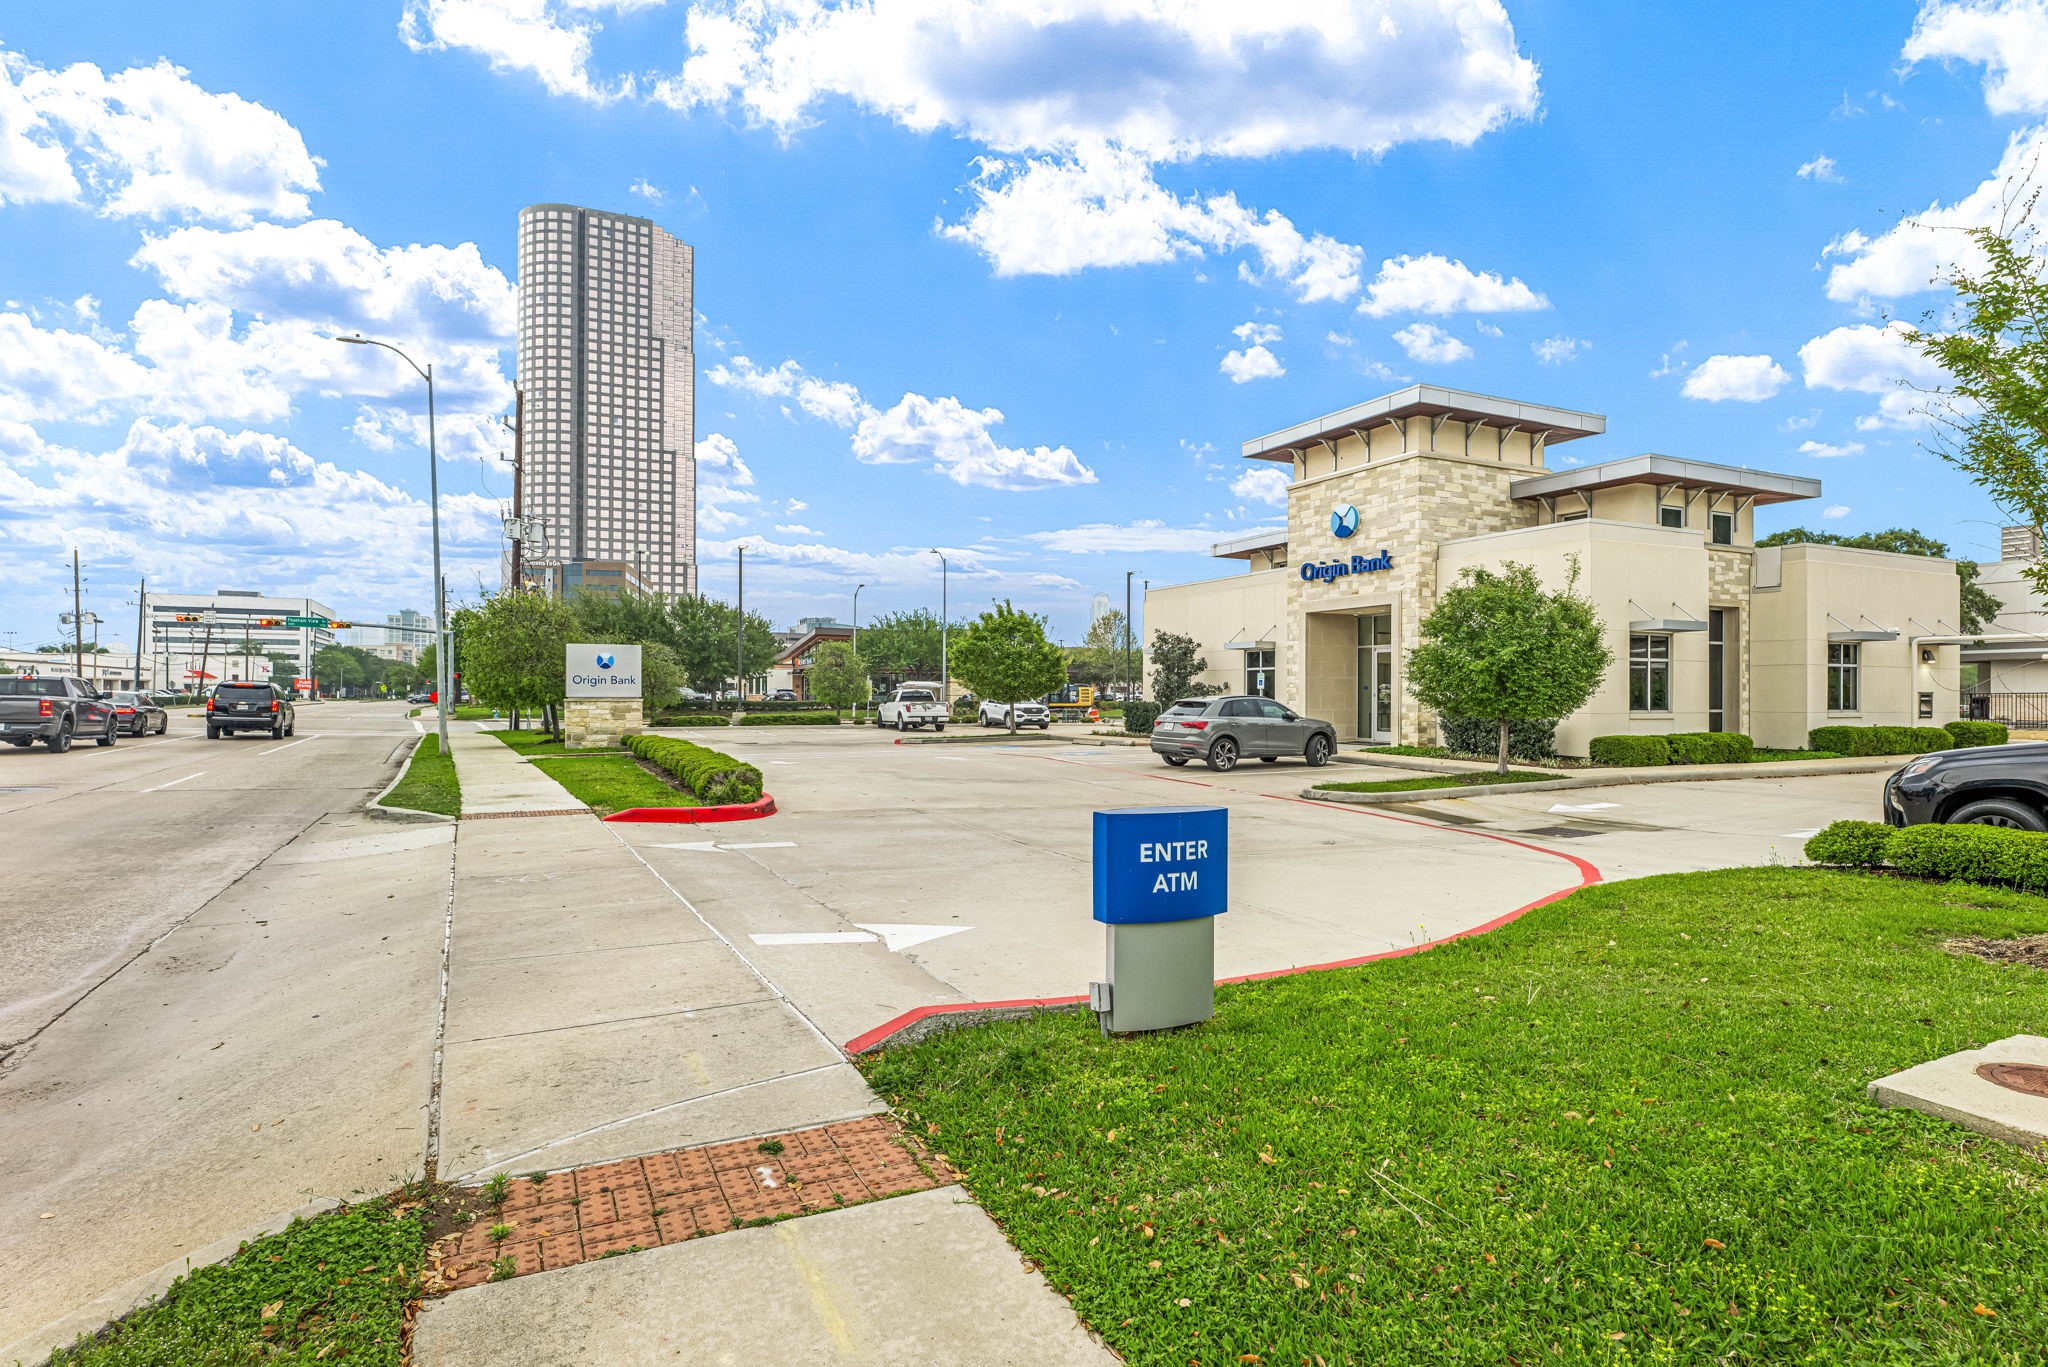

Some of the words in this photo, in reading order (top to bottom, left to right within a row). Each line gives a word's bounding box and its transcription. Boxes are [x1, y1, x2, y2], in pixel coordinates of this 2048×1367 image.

[1301, 559, 1349, 583] Origin
[1351, 550, 1393, 574] Bank
[572, 674, 606, 687] Origin
[610, 675, 636, 686] Bank
[1139, 840, 1208, 863] ENTER
[1152, 871, 1198, 894] ATM
